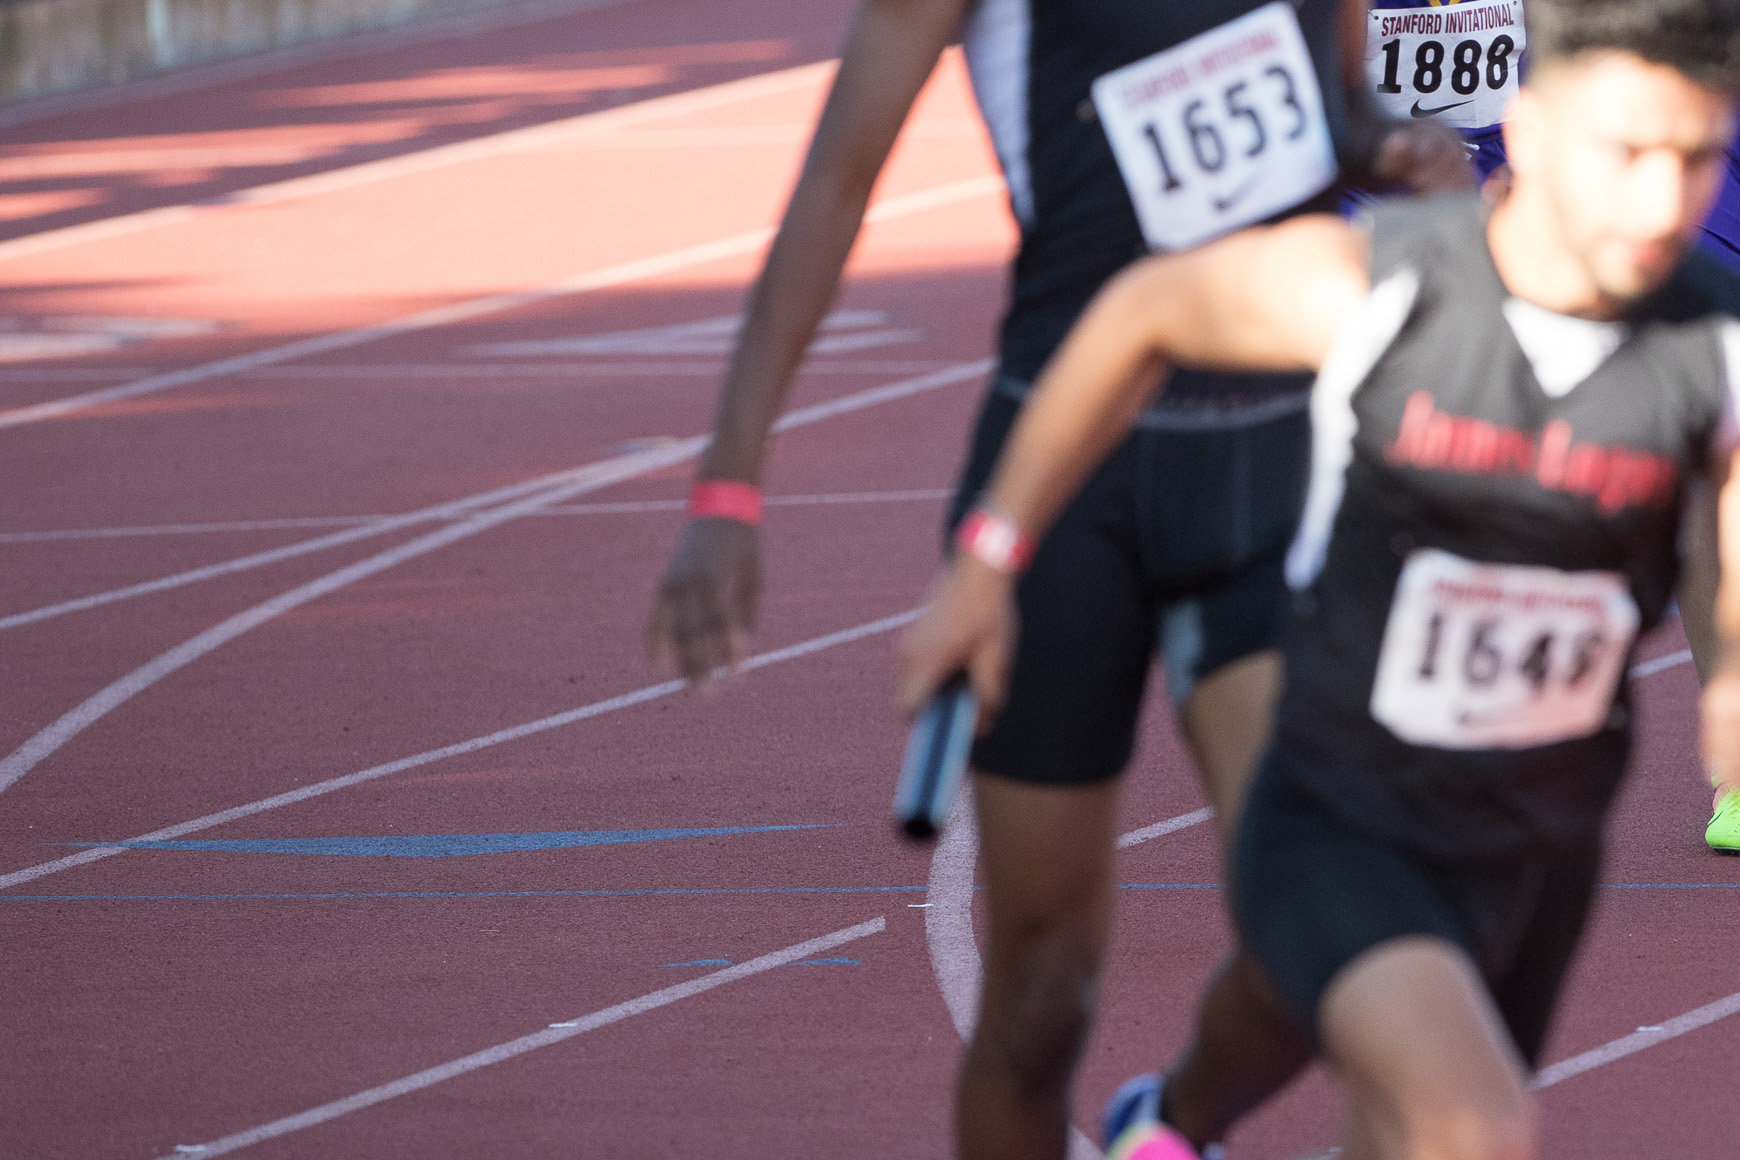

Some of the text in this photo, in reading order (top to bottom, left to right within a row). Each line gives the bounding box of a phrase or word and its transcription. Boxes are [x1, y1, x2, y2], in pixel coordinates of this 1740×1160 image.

[1381, 3, 1515, 37] STANFORD INVITATIONAL
[1141, 63, 1309, 194] 1653
